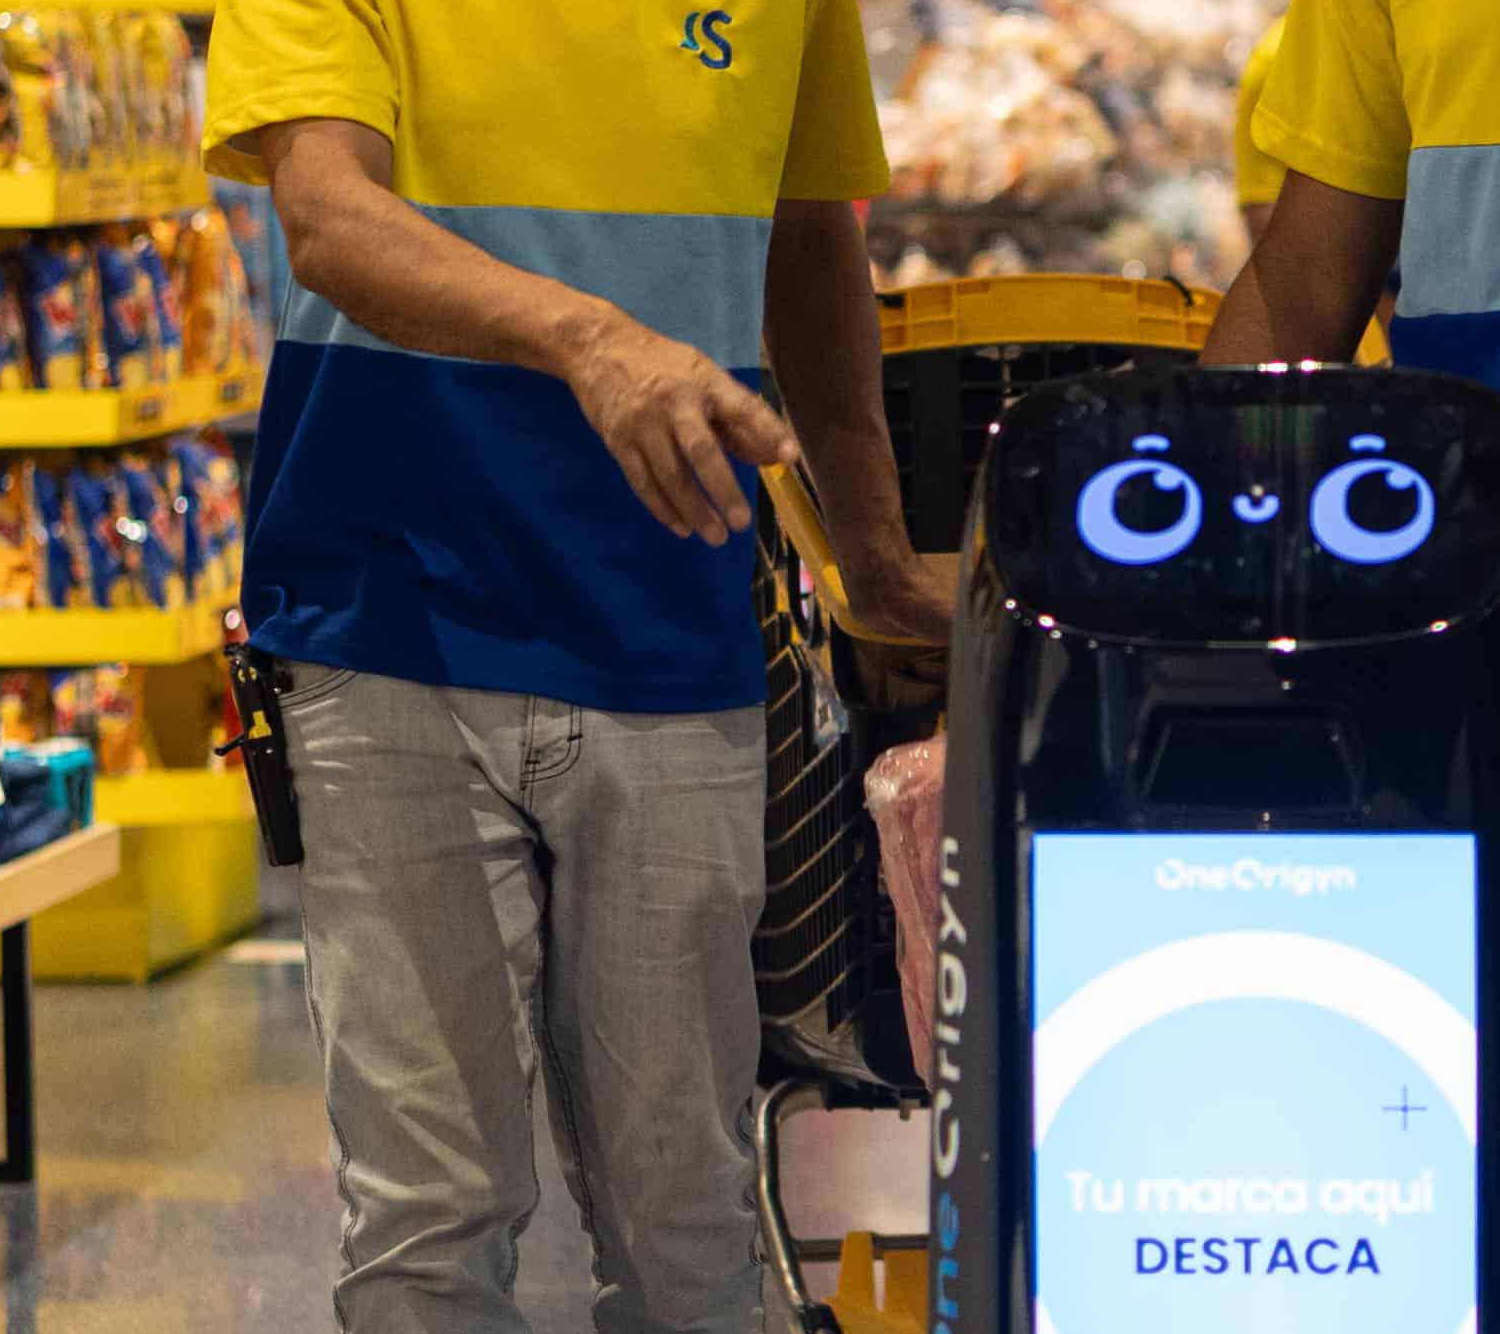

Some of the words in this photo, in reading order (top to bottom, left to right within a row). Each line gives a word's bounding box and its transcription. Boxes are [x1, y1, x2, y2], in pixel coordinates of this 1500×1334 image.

[1155, 858, 1358, 899] OneOrigyn
[1063, 1170, 1125, 1213] Tu
[1135, 1177, 1309, 1214] marca
[1318, 1165, 1438, 1228] aquí
[1134, 1236, 1382, 1276] DESTACA
